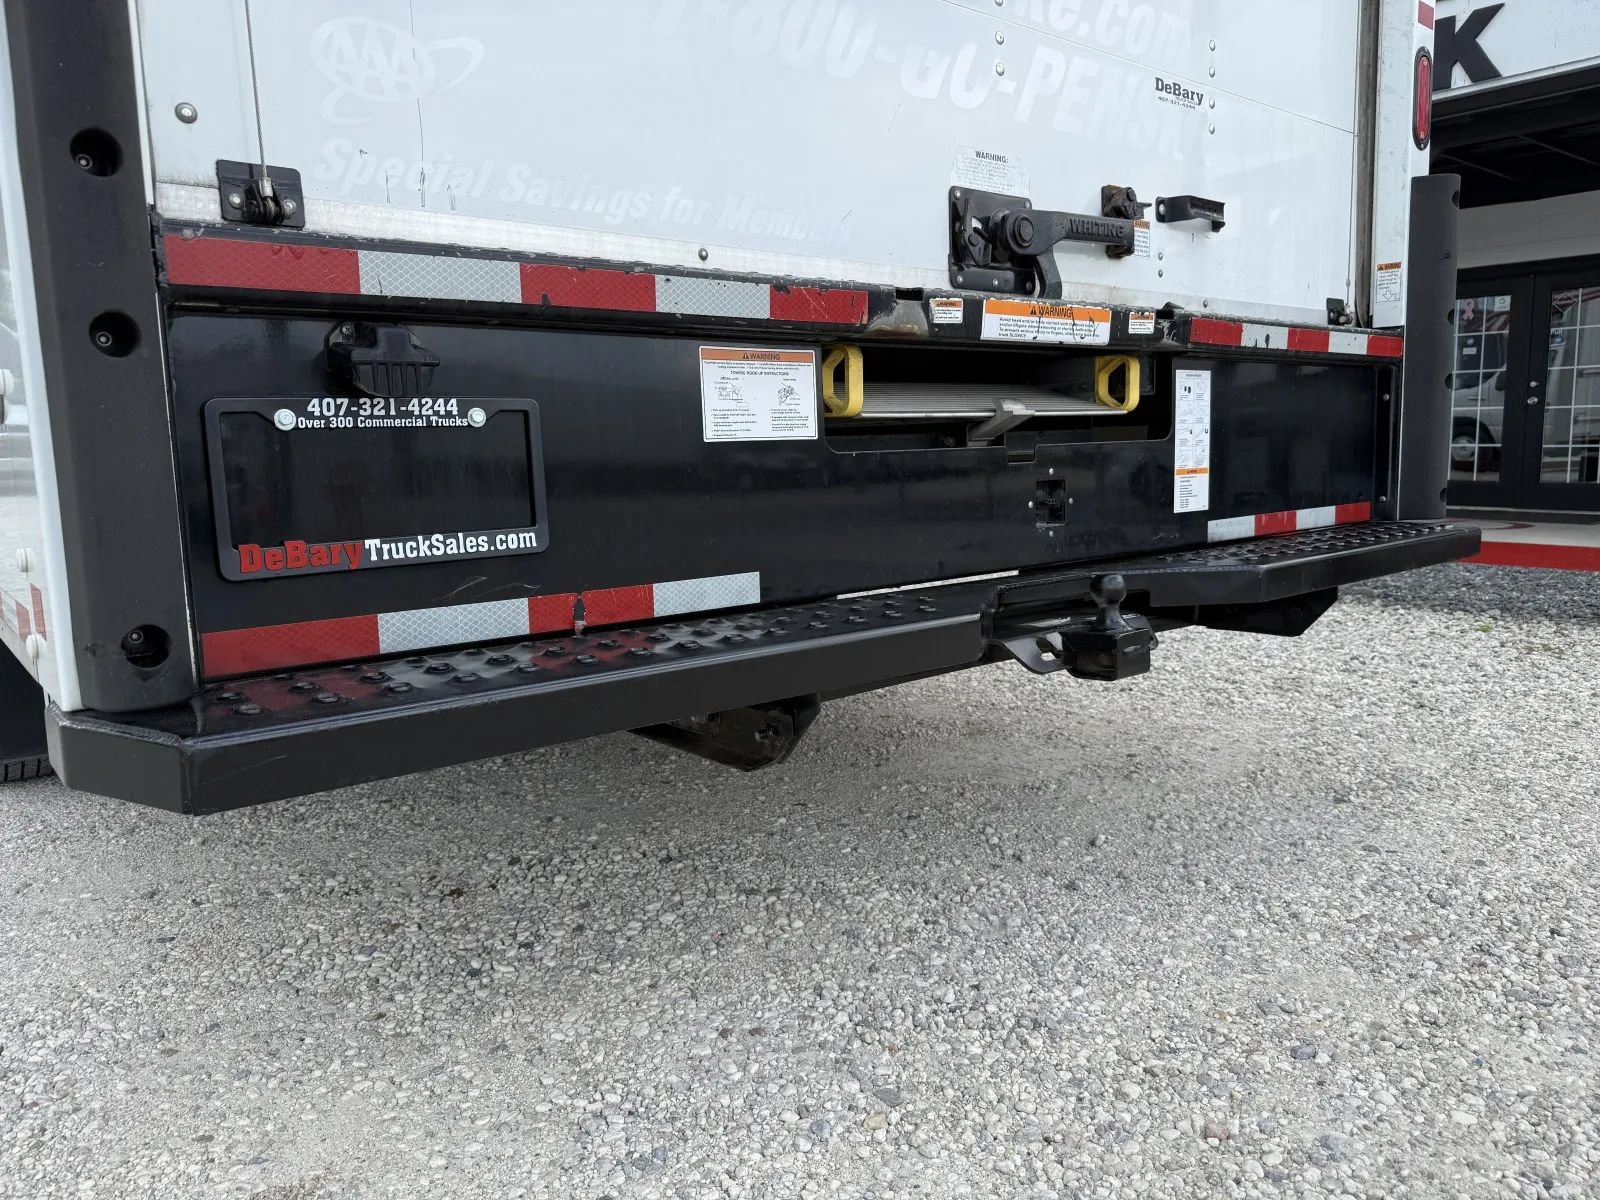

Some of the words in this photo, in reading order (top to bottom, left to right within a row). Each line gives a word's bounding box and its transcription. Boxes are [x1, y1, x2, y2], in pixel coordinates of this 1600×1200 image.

[1432, 2, 1506, 92] K
[1154, 76, 1204, 106] DeBary
[975, 150, 1009, 164] WARNING:
[312, 137, 497, 198] Special
[500, 162, 651, 225] Savings
[658, 184, 713, 226] for
[1069, 218, 1126, 238] WHITING
[1038, 305, 1072, 318] WARNING
[750, 353, 781, 361] WARNING
[307, 397, 458, 417] 407-321-4244
[297, 416, 326, 428] Over
[329, 416, 353, 428] 300
[357, 416, 427, 428] Commercial
[430, 415, 469, 427] Trucks
